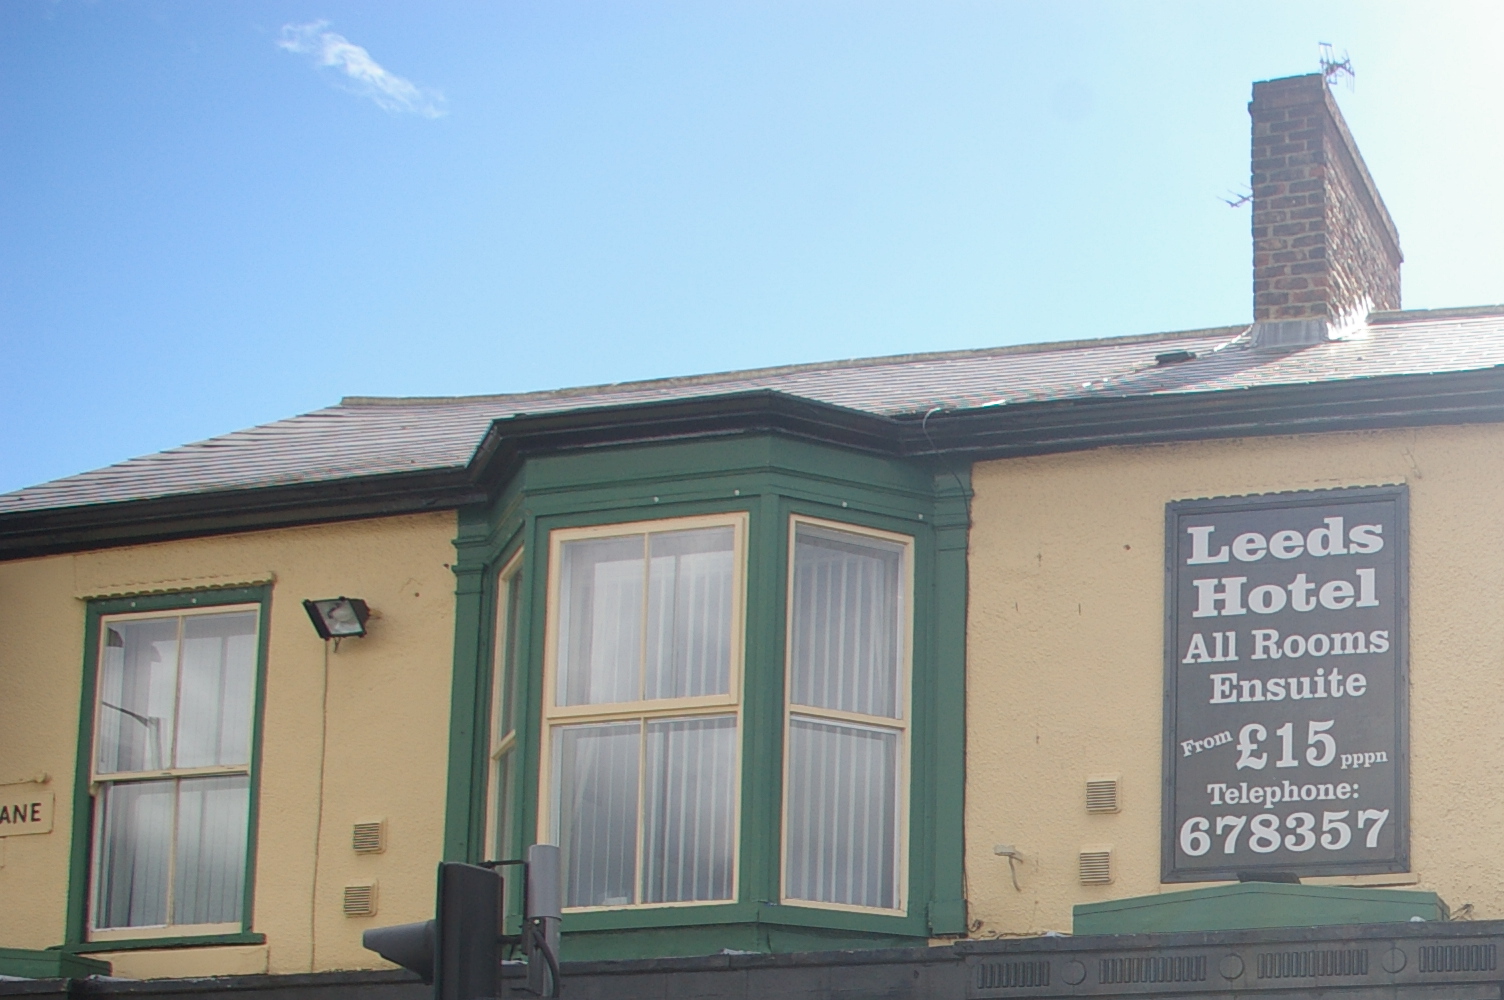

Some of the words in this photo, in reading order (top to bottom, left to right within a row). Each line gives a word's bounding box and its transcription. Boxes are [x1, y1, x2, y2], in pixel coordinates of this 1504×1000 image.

[1186, 516, 1384, 565] Leeds
[1192, 568, 1379, 618] Hotel
[1182, 631, 1239, 664] All
[1251, 628, 1390, 660] Rooms
[1209, 667, 1367, 704] Ensuite
[1180, 728, 1234, 757] From
[1236, 719, 1337, 770] £15
[1340, 748, 1388, 769] pppn
[1207, 780, 1360, 808] Telephone:
[1179, 808, 1390, 857] 678357
